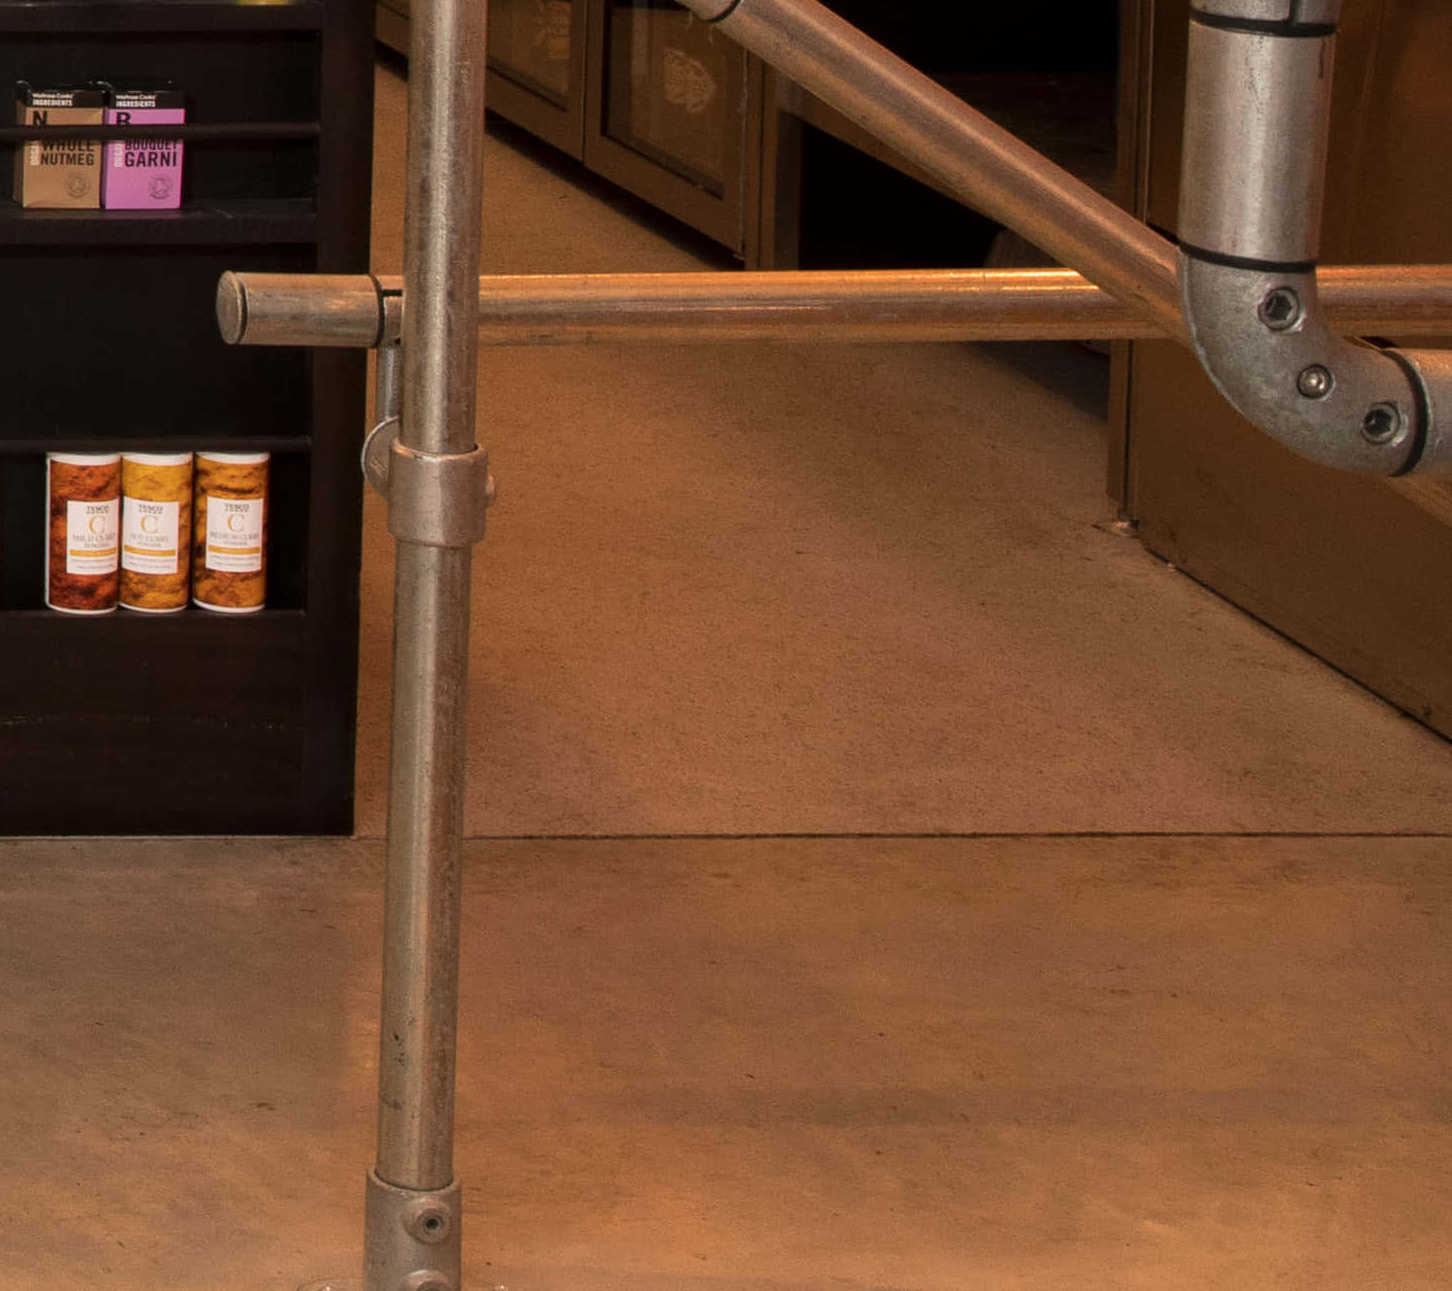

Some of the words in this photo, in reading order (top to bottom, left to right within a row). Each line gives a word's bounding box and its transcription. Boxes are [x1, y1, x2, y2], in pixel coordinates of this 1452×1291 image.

[33, 99, 73, 107] INGREDIENTS
[41, 140, 94, 152] WHOLE
[125, 140, 177, 150] BOUQUET
[41, 153, 94, 166] NUTMEG
[125, 152, 177, 167] GARNI
